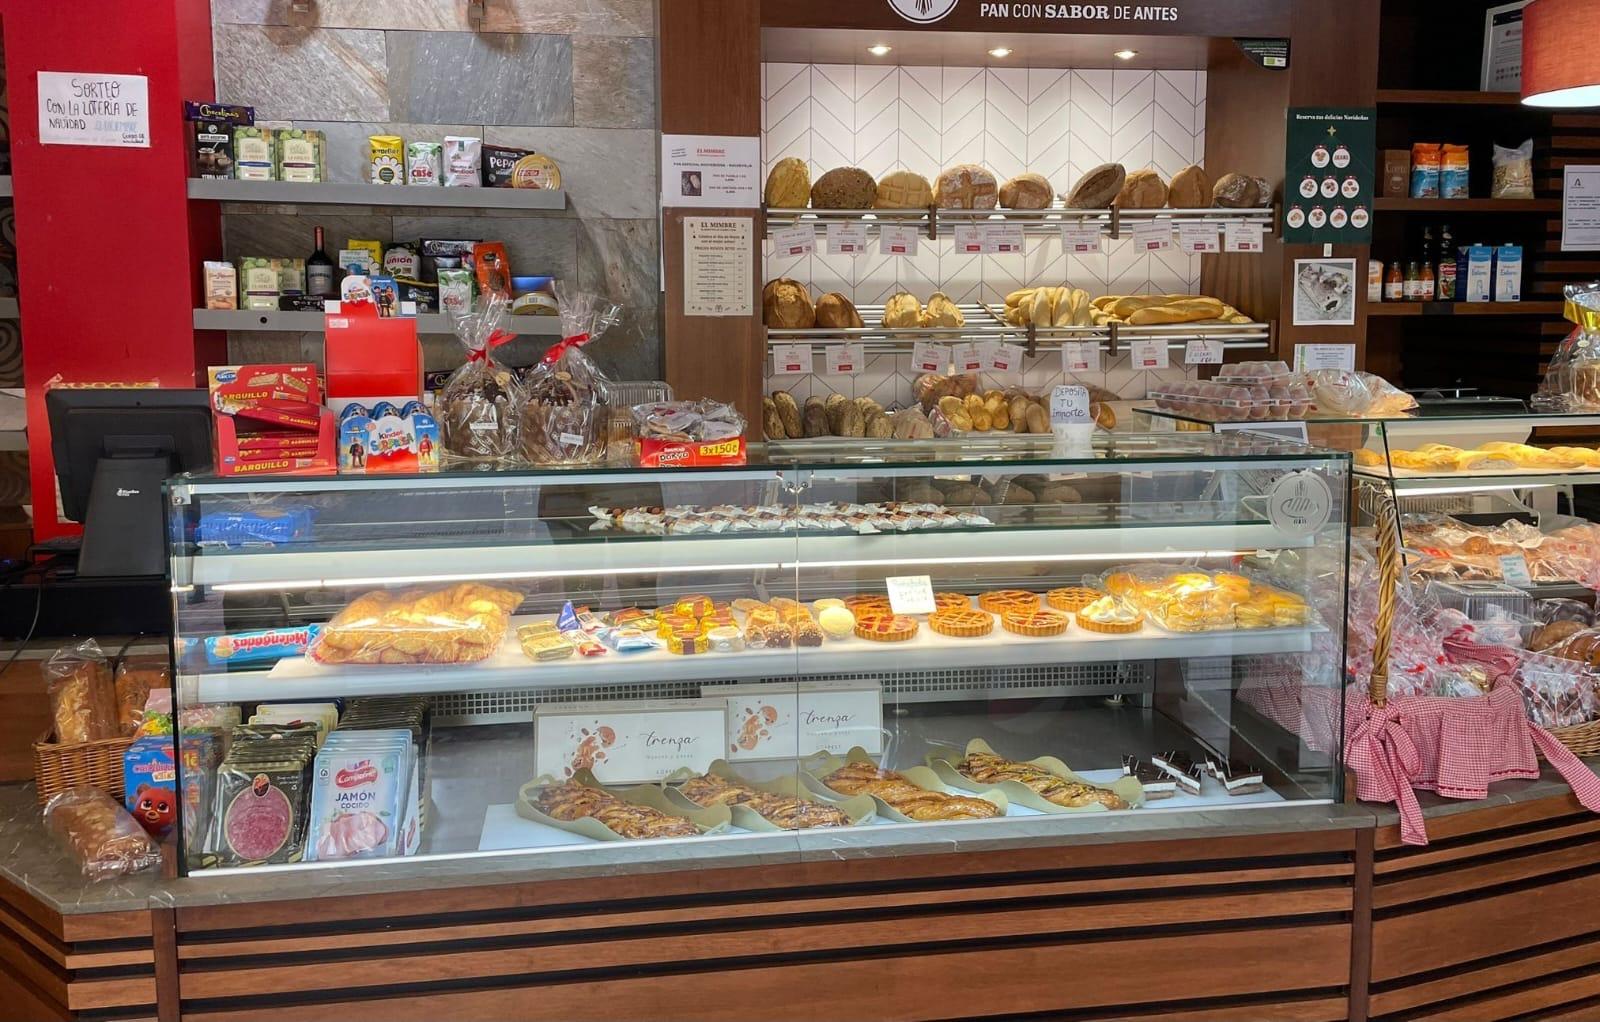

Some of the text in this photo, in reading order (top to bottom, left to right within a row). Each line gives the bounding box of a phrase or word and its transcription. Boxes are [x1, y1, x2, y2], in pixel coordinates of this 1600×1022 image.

[980, 3, 1178, 21] PAN CON SABOR DE ANTES
[71, 78, 121, 99] SORTEO
[126, 102, 138, 117] DE
[49, 118, 86, 130] NAVIDAD
[1054, 386, 1087, 398] DEPOSITA
[1060, 398, 1073, 408] TU
[234, 460, 289, 473] BARQUILLO
[801, 710, 856, 729] trenza
[641, 730, 698, 752] trenza
[335, 790, 376, 801] JAMÓN
